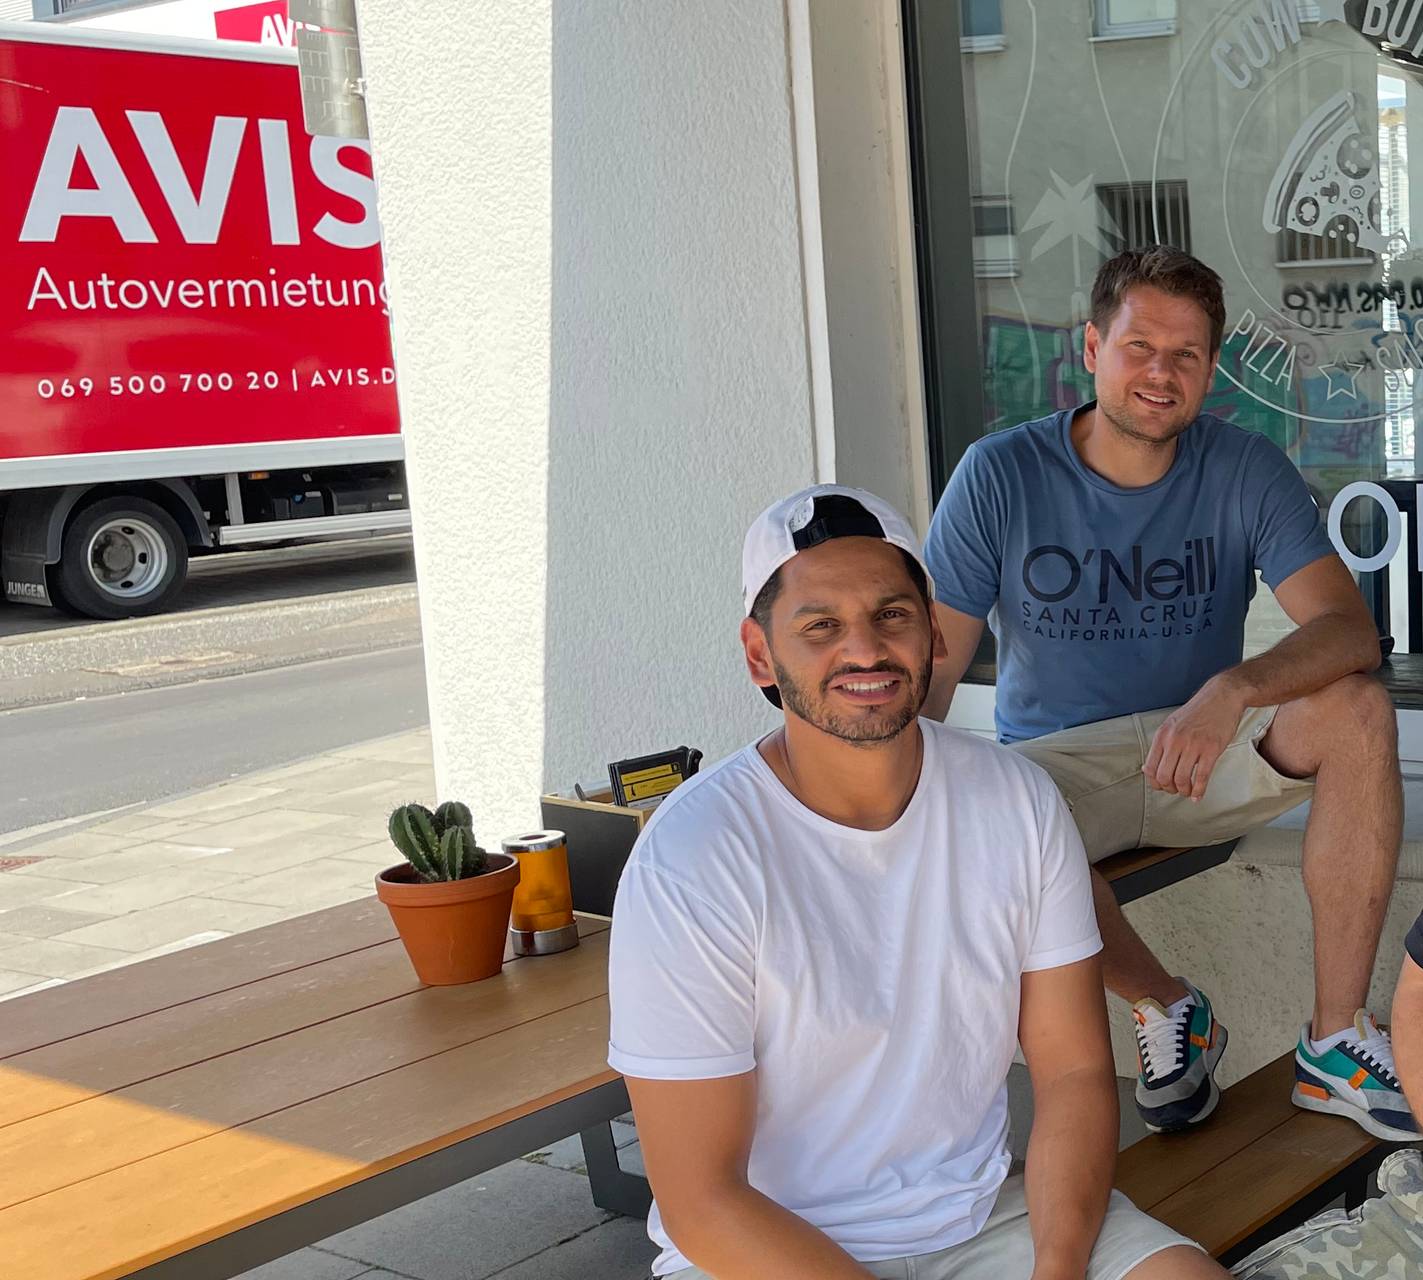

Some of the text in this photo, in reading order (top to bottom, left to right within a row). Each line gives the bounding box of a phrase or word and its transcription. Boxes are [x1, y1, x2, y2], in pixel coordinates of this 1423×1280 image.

[1211, 0, 1301, 89] COW
[18, 105, 382, 250] AVIS
[38, 367, 395, 398] 069 500 700 20 AVIS.D
[1225, 308, 1297, 391] PIZZA
[1022, 536, 1217, 604] O'Neill
[1022, 596, 1213, 625] SANTA CRUZ
